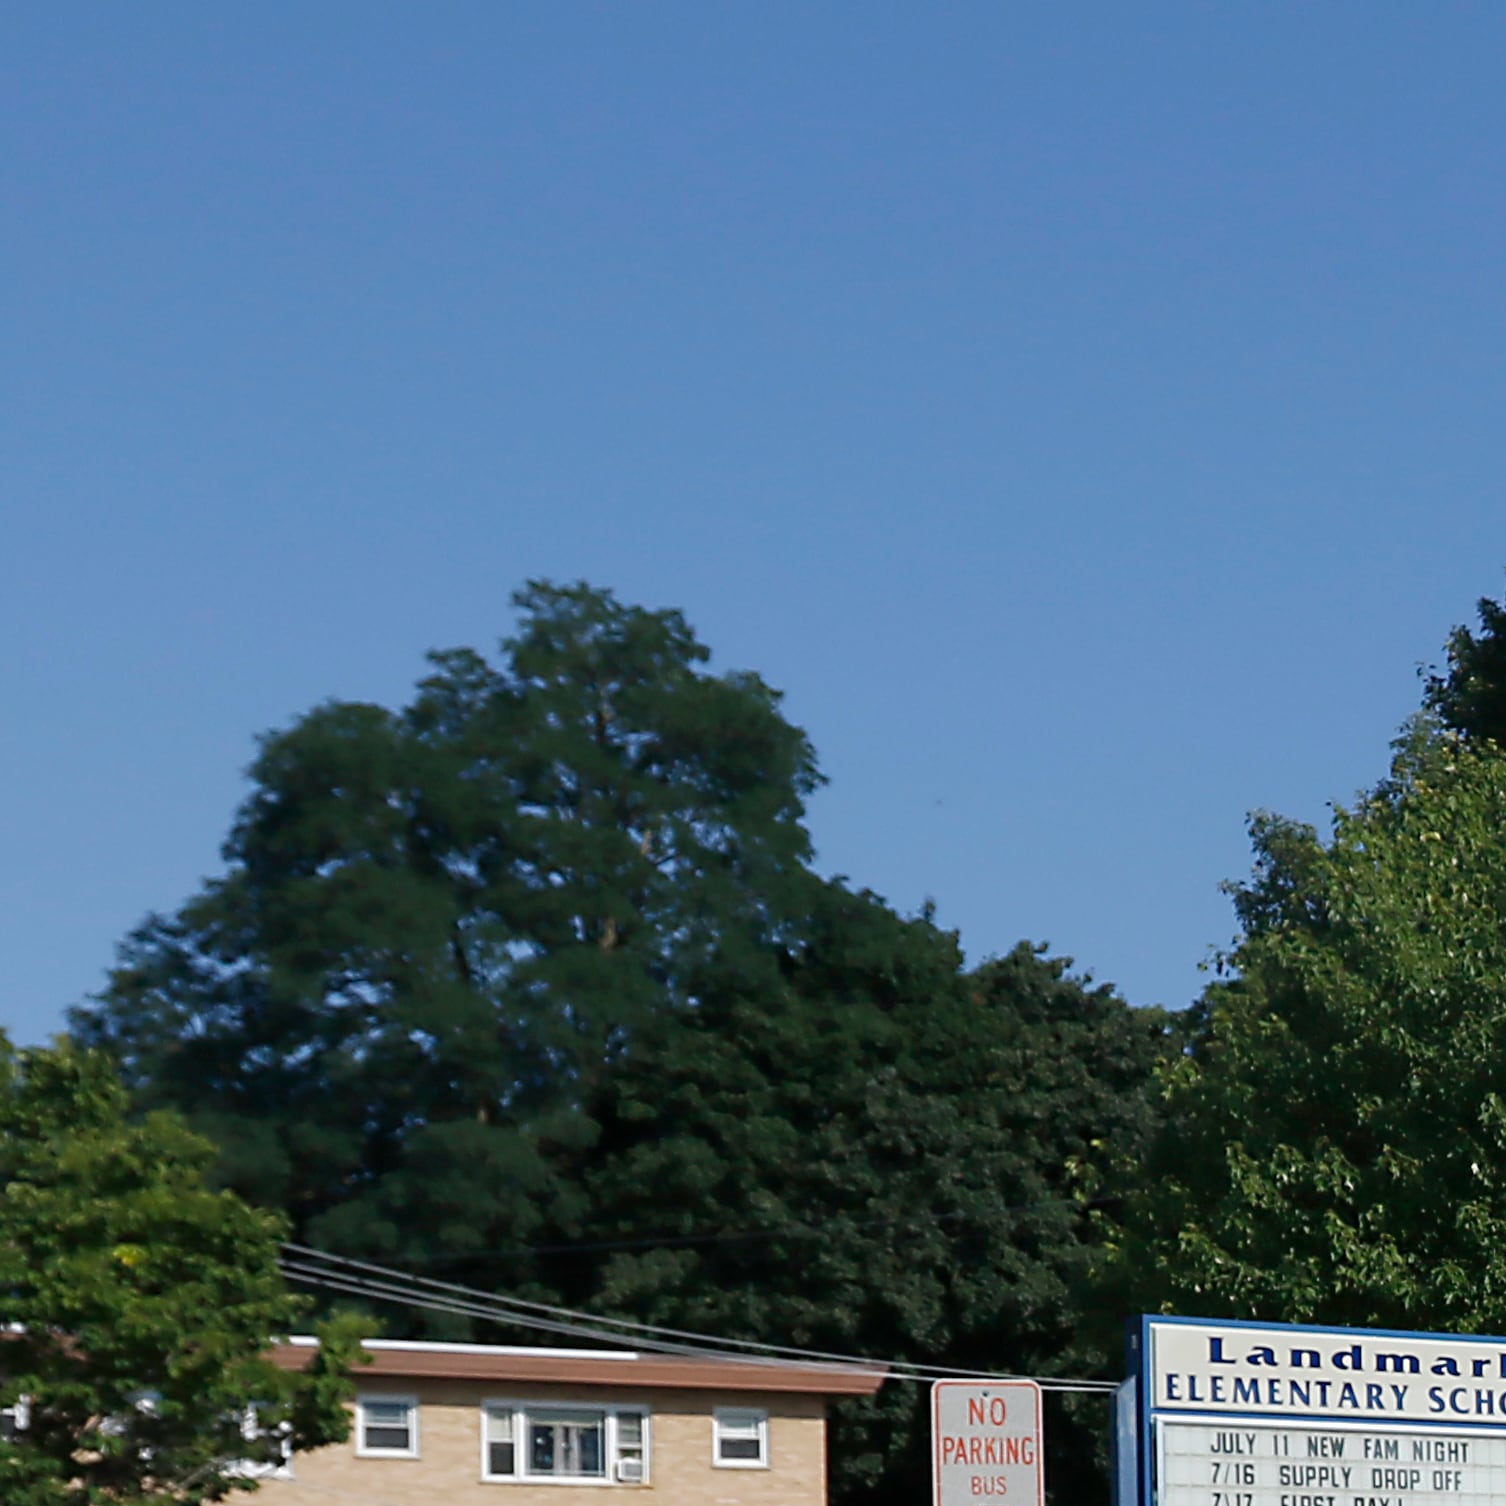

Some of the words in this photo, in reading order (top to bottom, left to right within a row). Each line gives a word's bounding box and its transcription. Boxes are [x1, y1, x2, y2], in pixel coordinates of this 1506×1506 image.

[1166, 1372, 1409, 1411] ELEMENTARY
[969, 1398, 1005, 1425] NO
[942, 1437, 1033, 1465] PARKING
[1210, 1432, 1256, 1455] JULY
[1273, 1434, 1288, 1456] 11
[1307, 1436, 1345, 1458] NEW
[1363, 1438, 1399, 1460] FAM
[1413, 1440, 1469, 1463] NIGHT
[971, 1476, 1007, 1495] BUS
[1211, 1462, 1255, 1485] 7/16
[1279, 1465, 1352, 1488] SUPPLY
[1371, 1468, 1421, 1490] DROP
[1433, 1470, 1462, 1491] OFF
